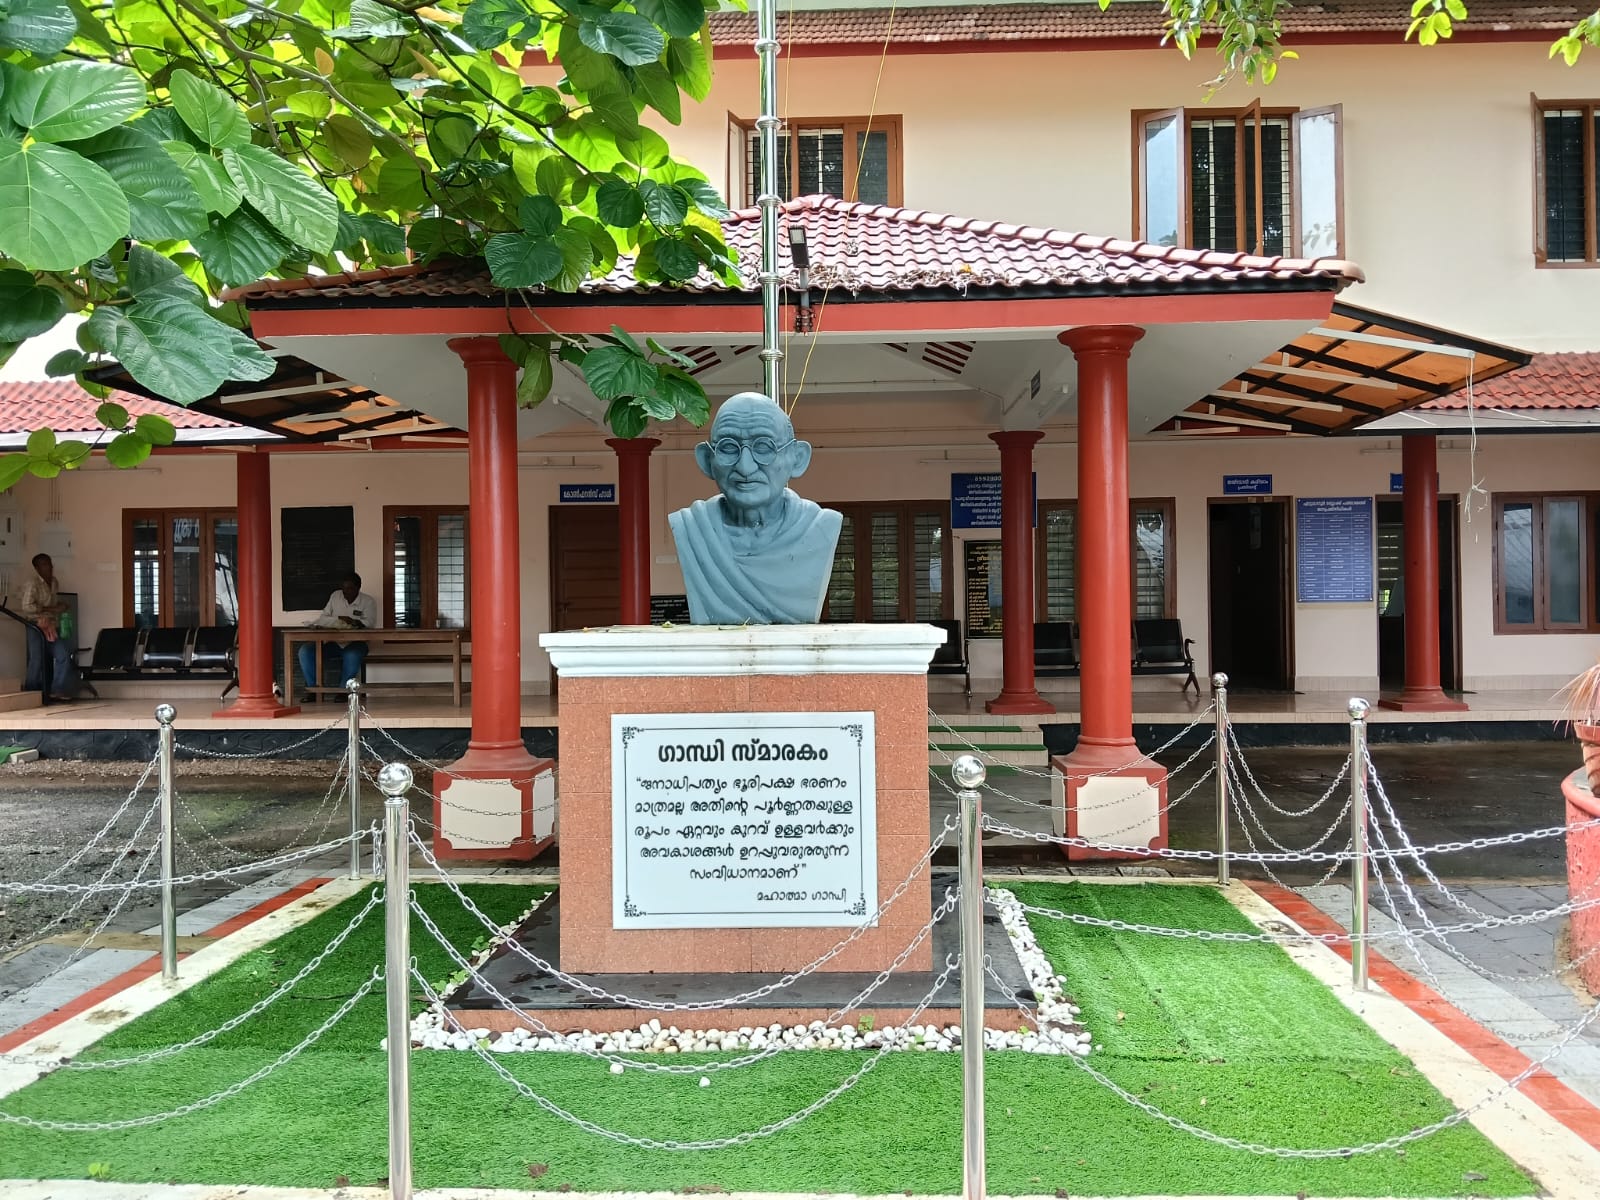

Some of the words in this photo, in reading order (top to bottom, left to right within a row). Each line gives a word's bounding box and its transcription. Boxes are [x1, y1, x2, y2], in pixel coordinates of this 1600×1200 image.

[658, 739, 724, 762] ഗാന്ധി
[732, 738, 828, 761] സ്മാരകം
[733, 775, 795, 792] ഭൂരിപക്ഷ
[801, 777, 847, 788] ഭരണം
[635, 802, 684, 816] മാത്രമല്ല
[691, 797, 748, 816] അതിന്റെ
[754, 797, 853, 816] പൂർണ്ണതയുള്ള
[635, 826, 670, 839] രൂപം
[676, 825, 725, 839] ഏറ്റവും
[731, 820, 770, 838] കുറവ്
[775, 820, 854, 838] ഉള്ളവർക്കും
[640, 843, 734, 857] അവകാശങ്ങൾ
[740, 845, 849, 860] ഉറപ്പുവരുത്തുന്ന
[757, 891, 807, 901] മഹാത്മാ
[812, 888, 846, 902] ഗാന്ധി
